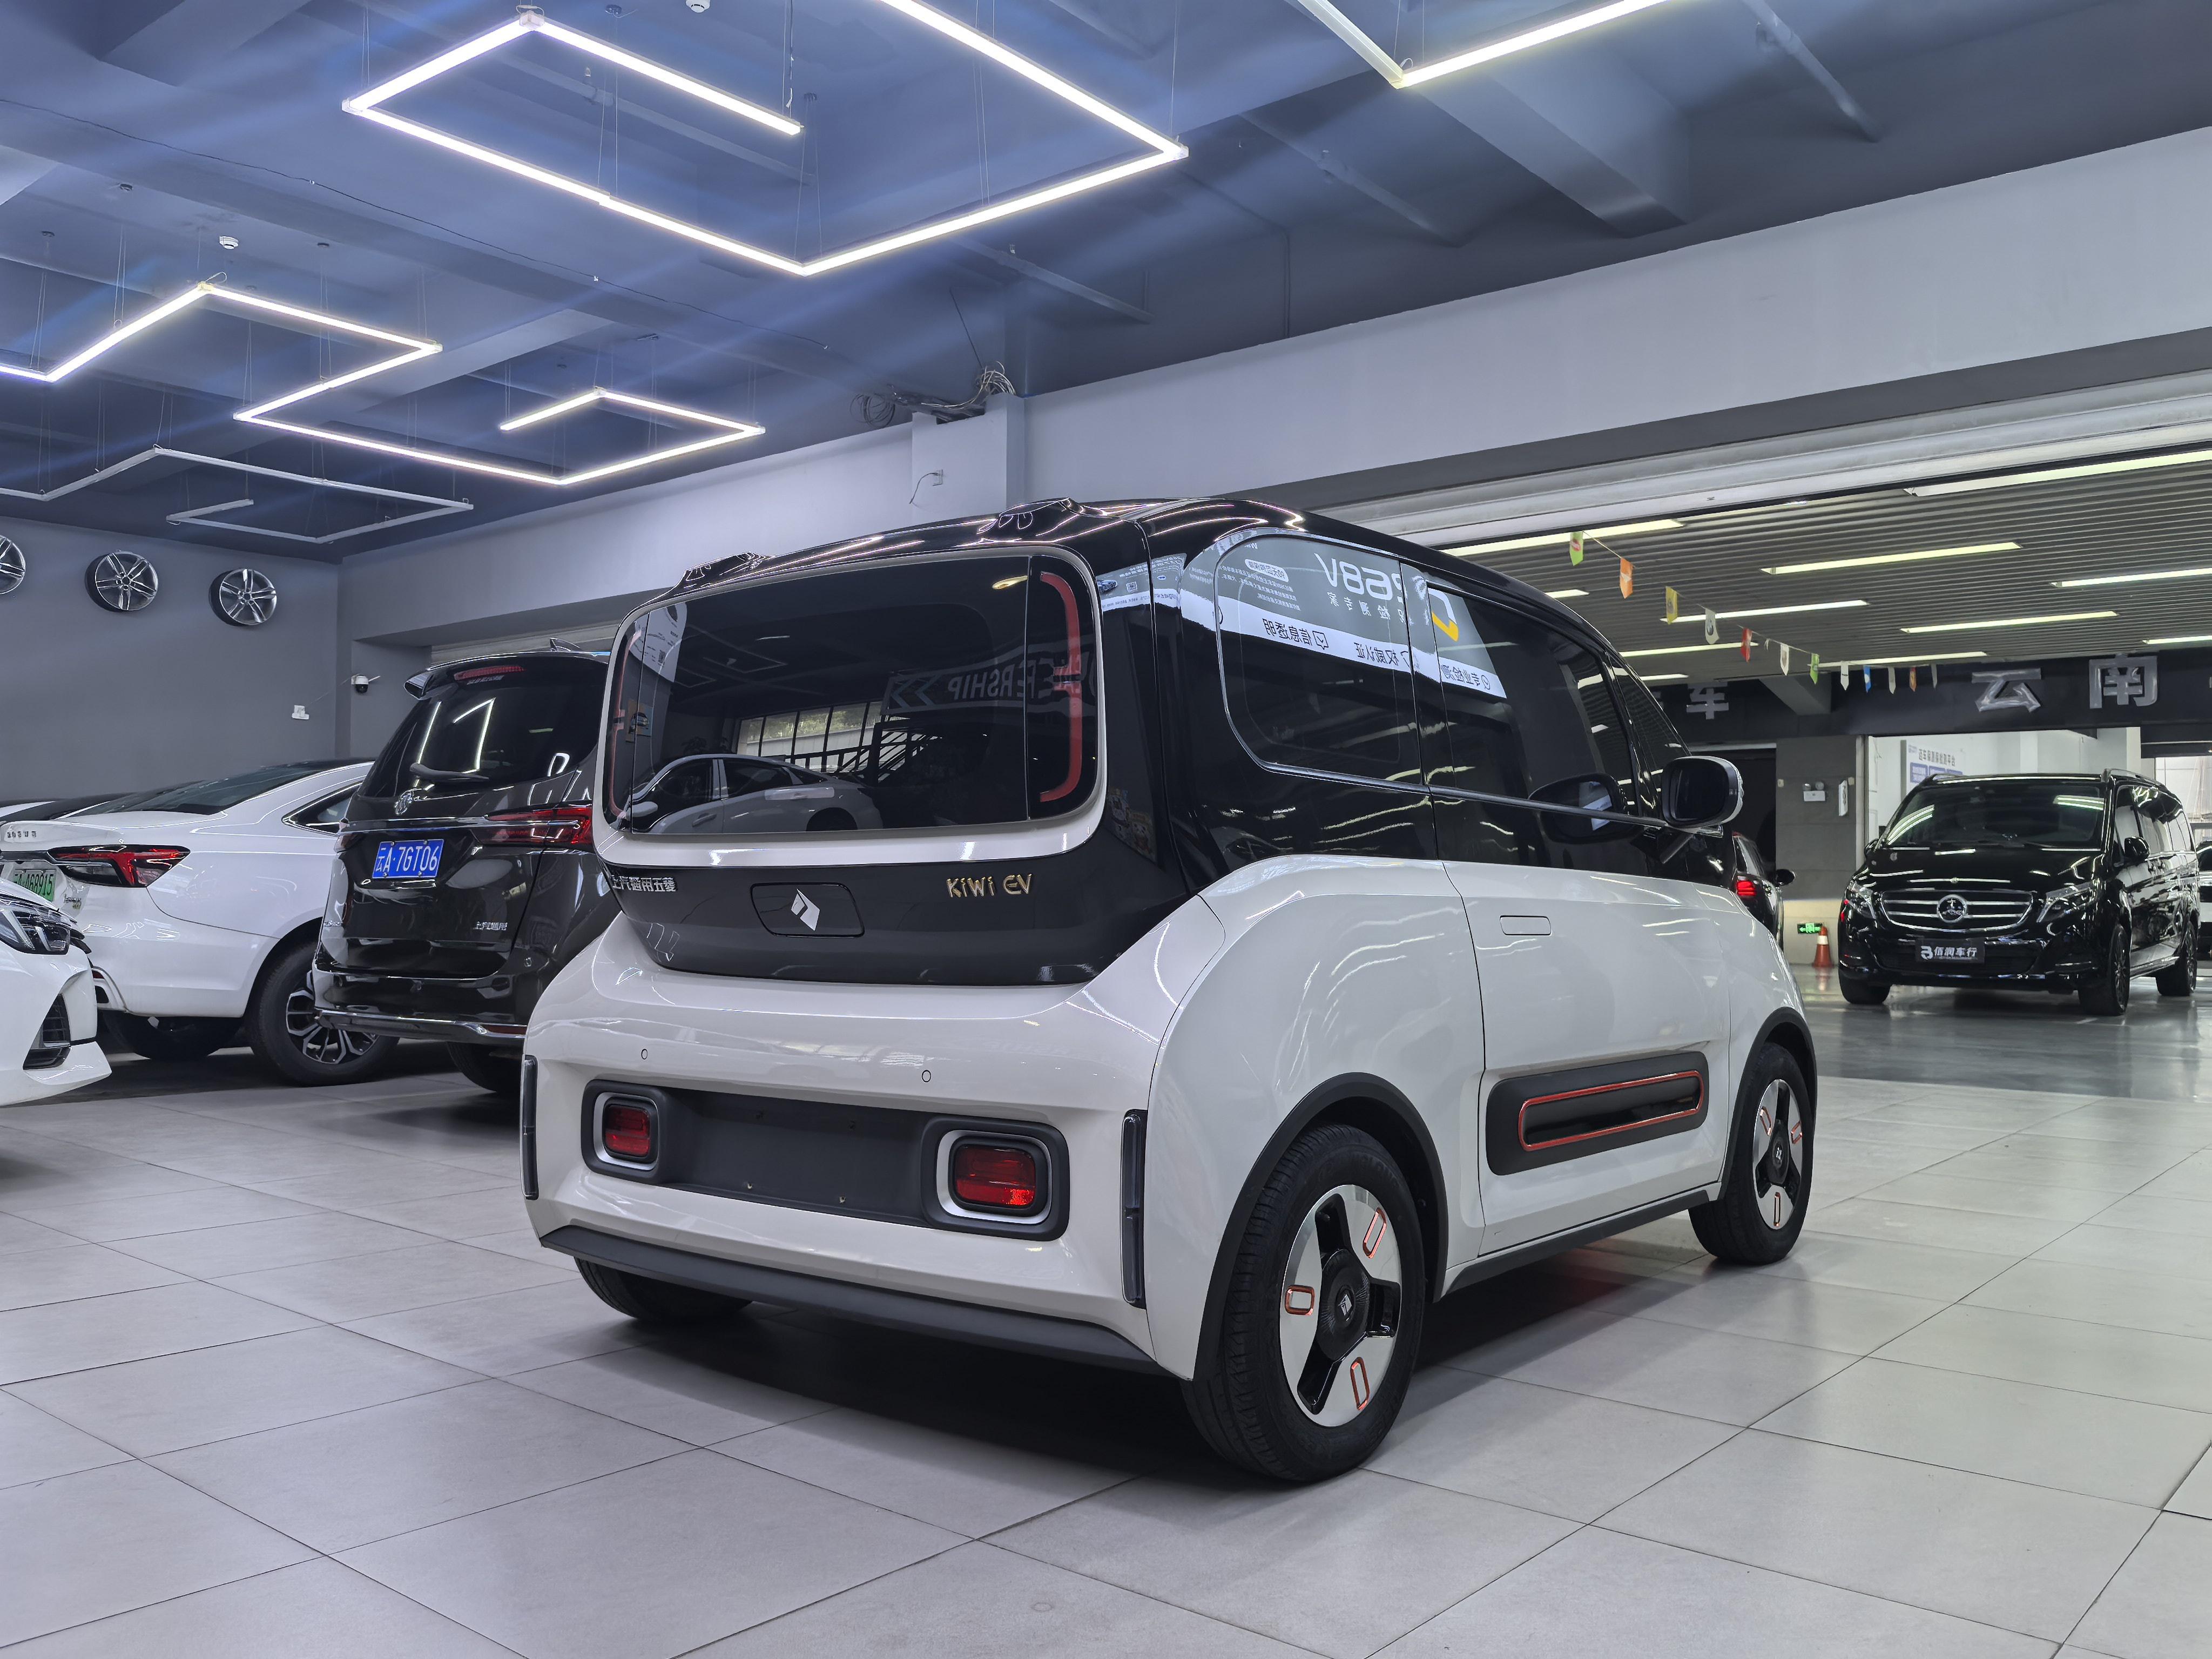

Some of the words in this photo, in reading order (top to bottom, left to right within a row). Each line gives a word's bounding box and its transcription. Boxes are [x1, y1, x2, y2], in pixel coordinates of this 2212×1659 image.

[1971, 653, 2158, 712] 云南
[612, 875, 677, 892] 上汽通用五菱
[1002, 873, 1033, 895] EV
